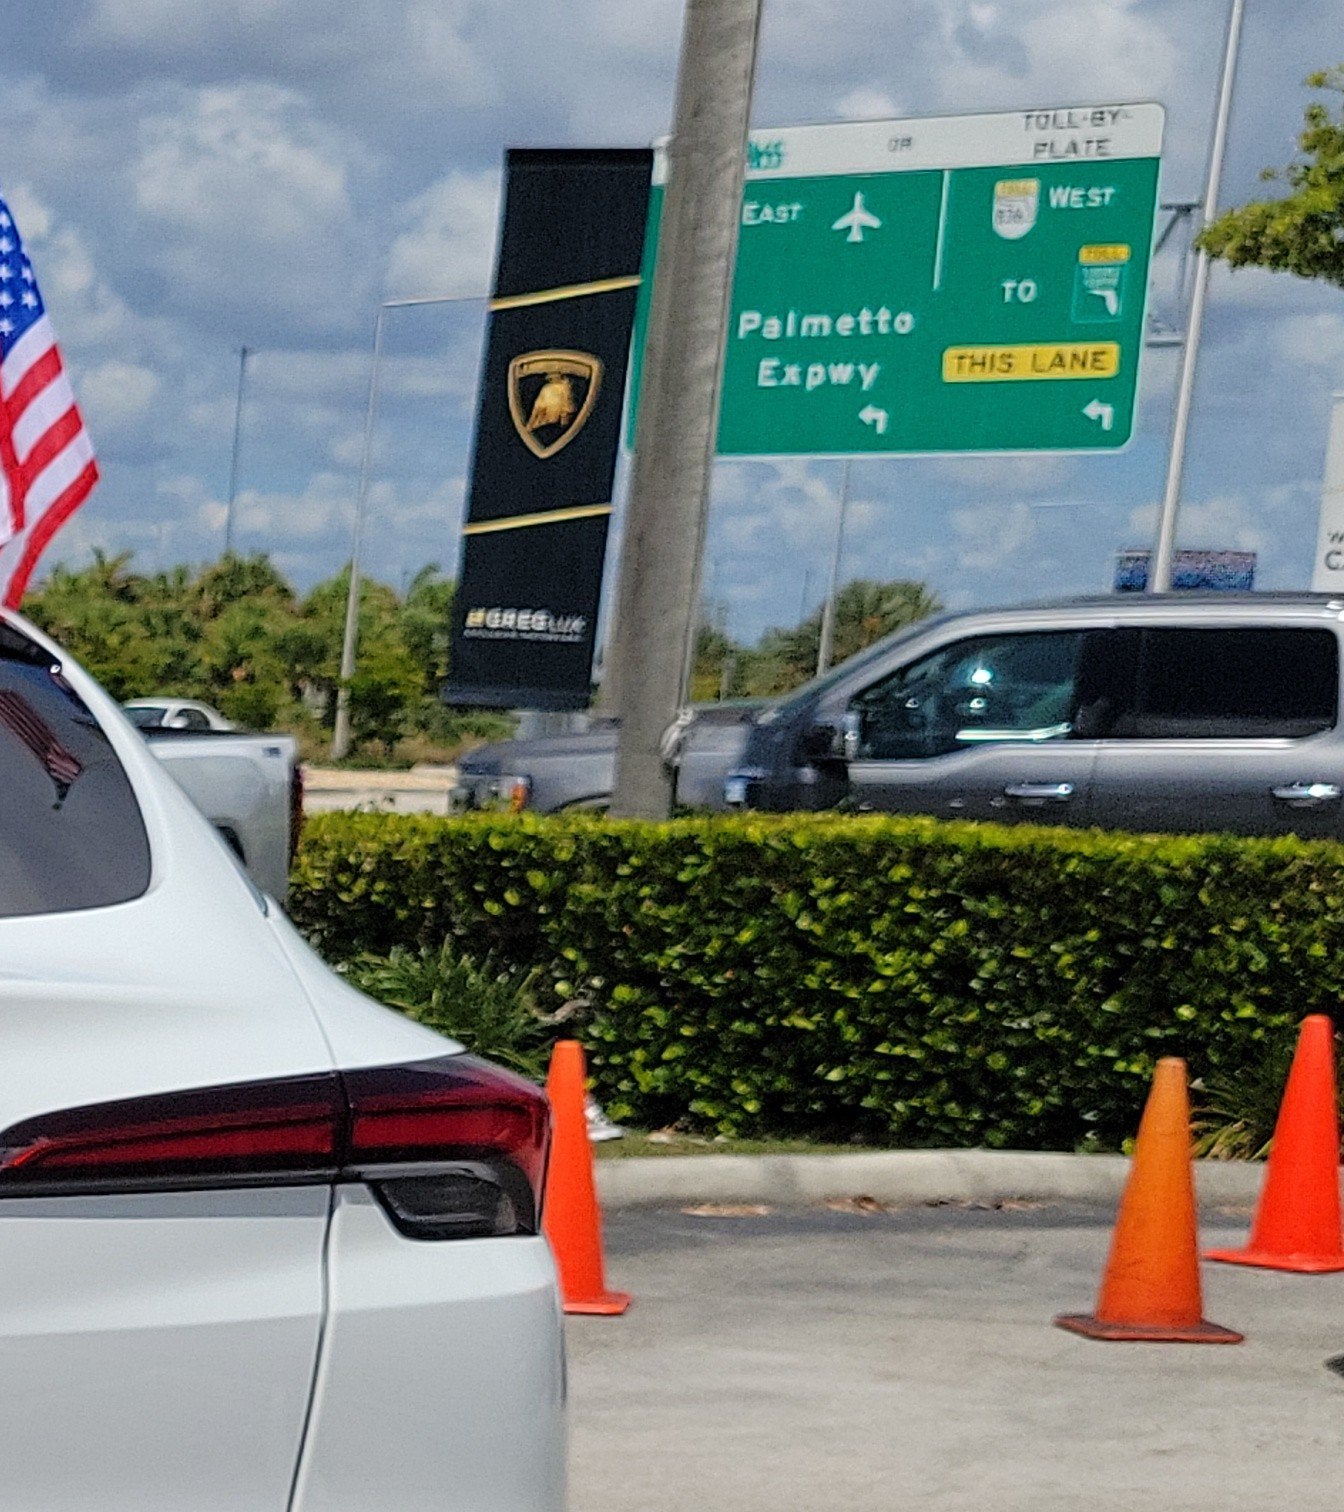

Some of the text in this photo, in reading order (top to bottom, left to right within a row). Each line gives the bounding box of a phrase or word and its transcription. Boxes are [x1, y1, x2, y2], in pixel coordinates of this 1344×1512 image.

[1033, 138, 1111, 159] PLATE
[1048, 186, 1116, 209] WEST
[742, 201, 803, 226] EAST
[1002, 278, 1038, 303] TO
[737, 304, 915, 341] Palmetto
[757, 356, 881, 392] Expwy
[955, 350, 1110, 375] THIS LANE
